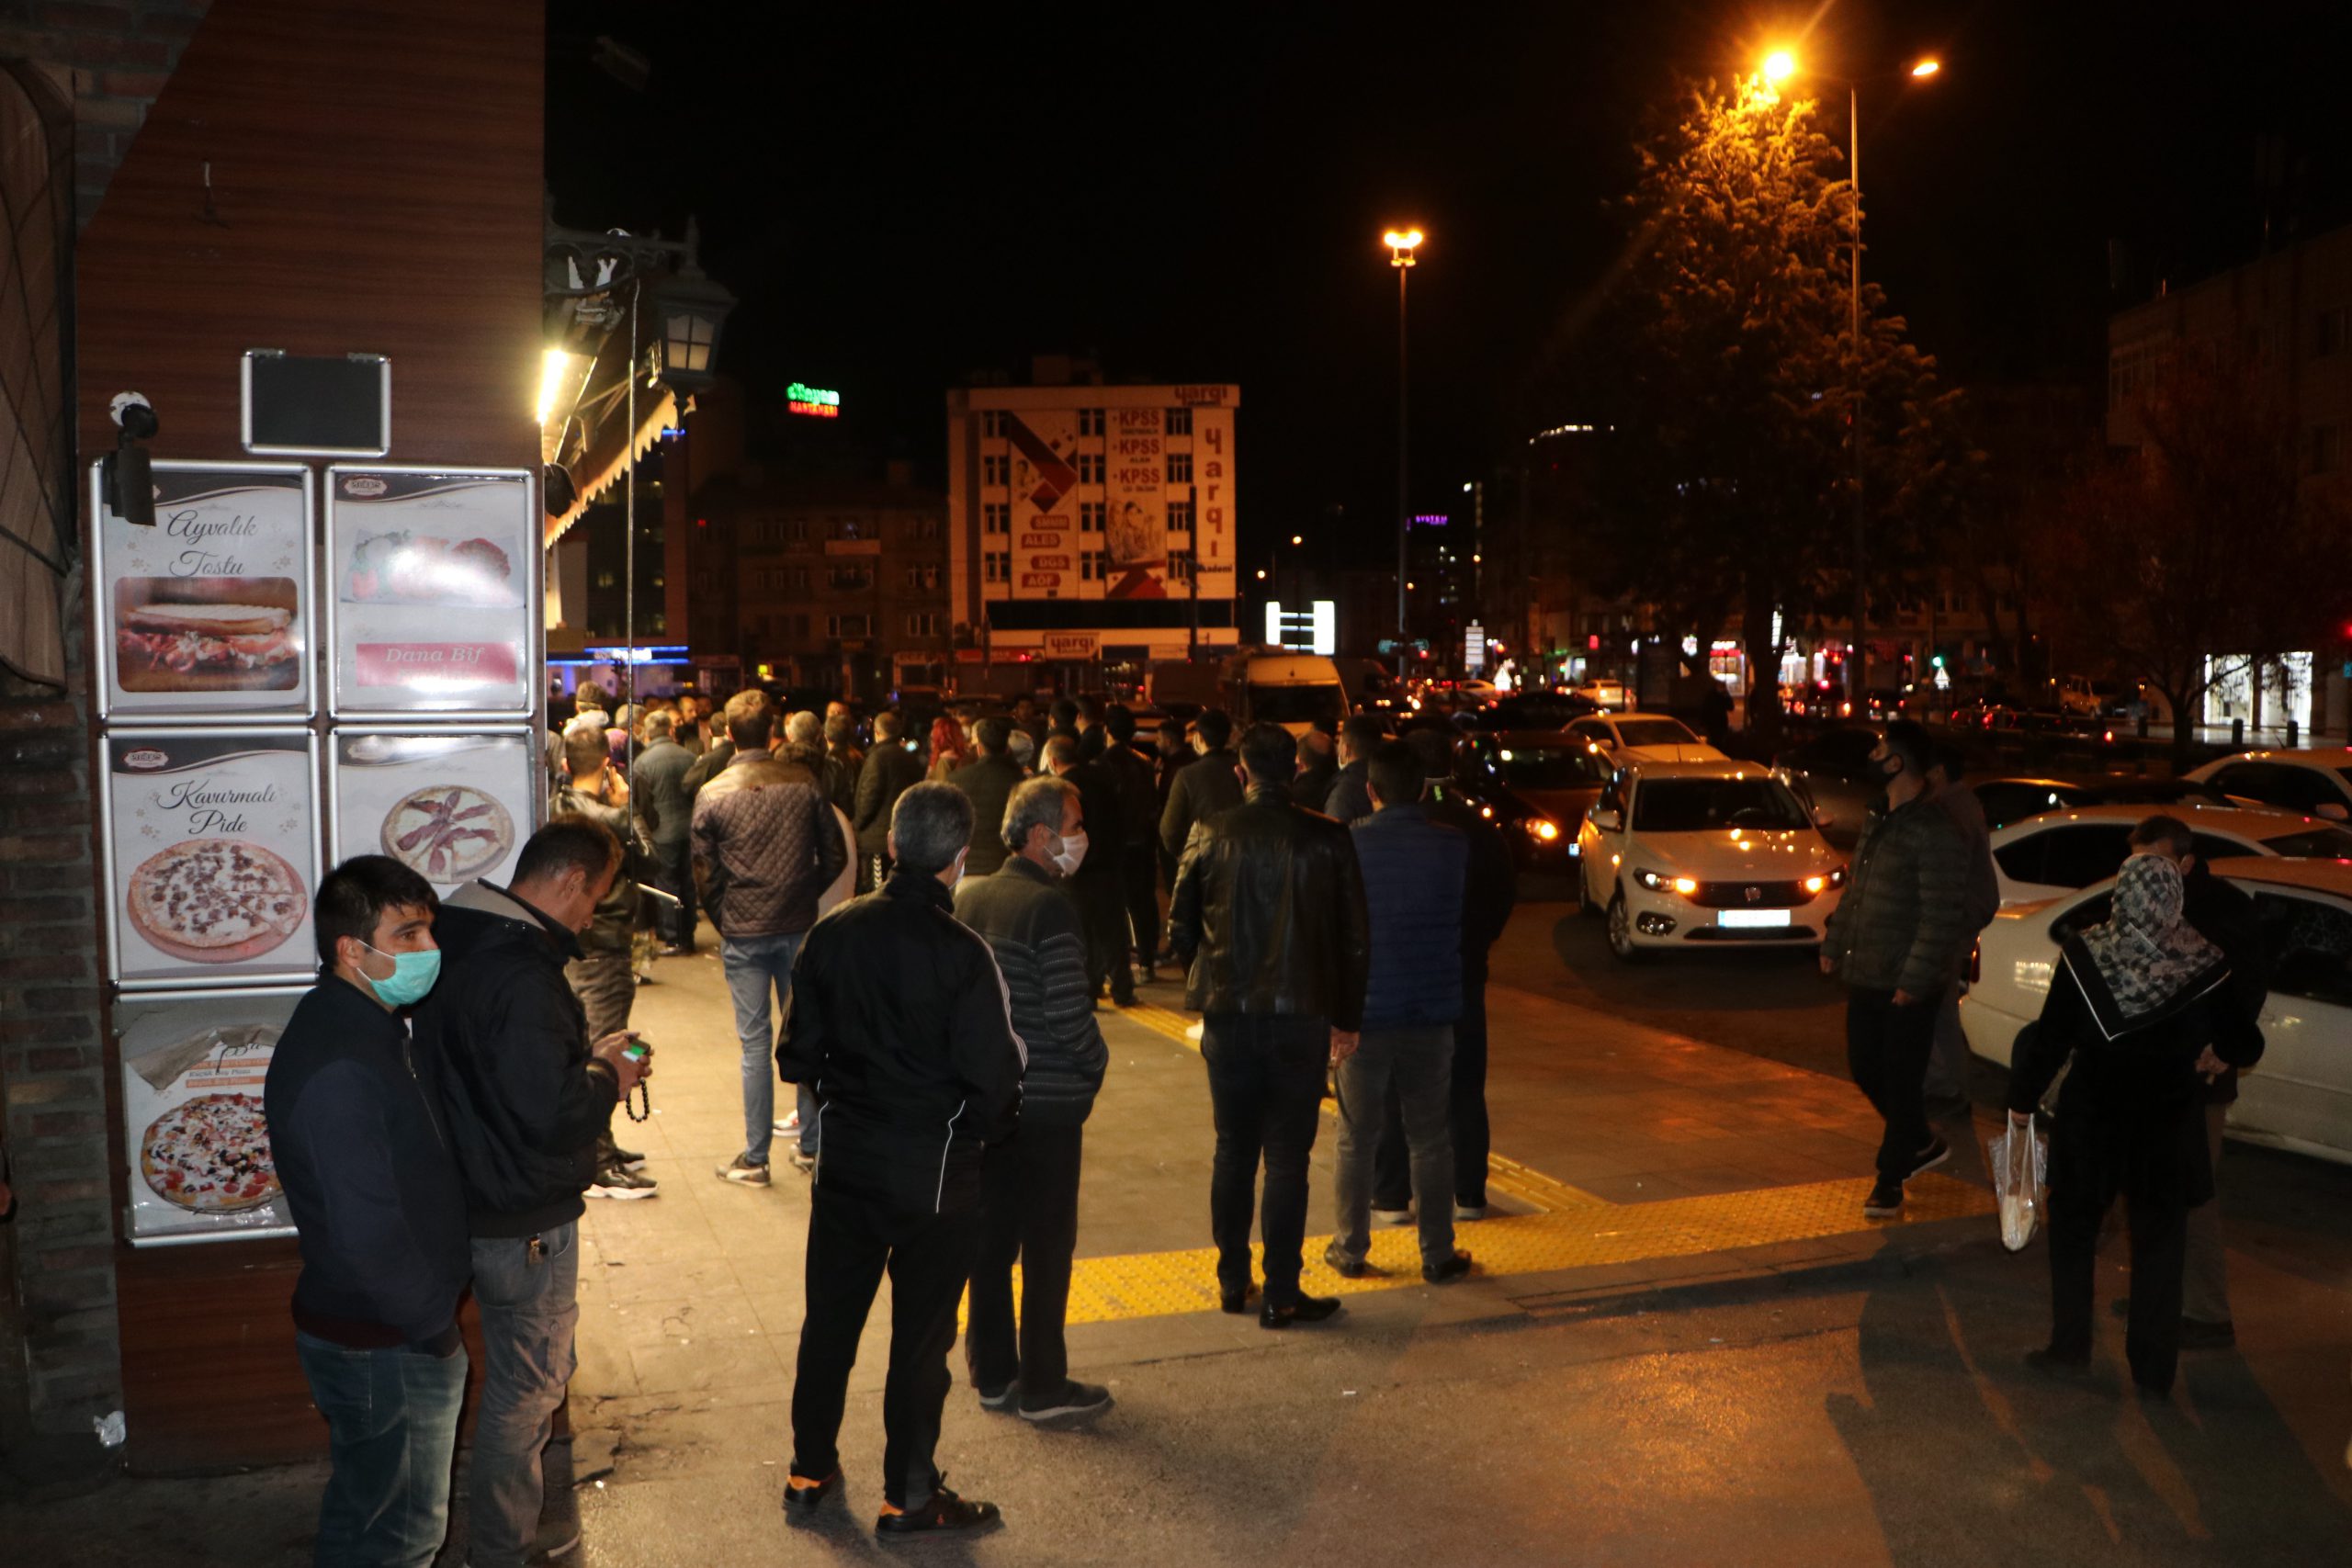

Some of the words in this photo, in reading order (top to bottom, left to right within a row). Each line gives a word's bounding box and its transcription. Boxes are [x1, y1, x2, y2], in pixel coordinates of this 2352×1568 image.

[1119, 410, 1159, 426] KPSS
[1119, 439, 1159, 455] KPSS
[1119, 468, 1159, 484] KPSS
[167, 510, 257, 545] Ayvalık
[1025, 535, 1058, 546] ALES
[168, 550, 244, 577] Tostu
[1038, 557, 1066, 568] DGS
[385, 648, 444, 662] Dana
[450, 647, 486, 663] Bif
[155, 778, 276, 809] Kavurmalı
[188, 809, 249, 834] Pide
